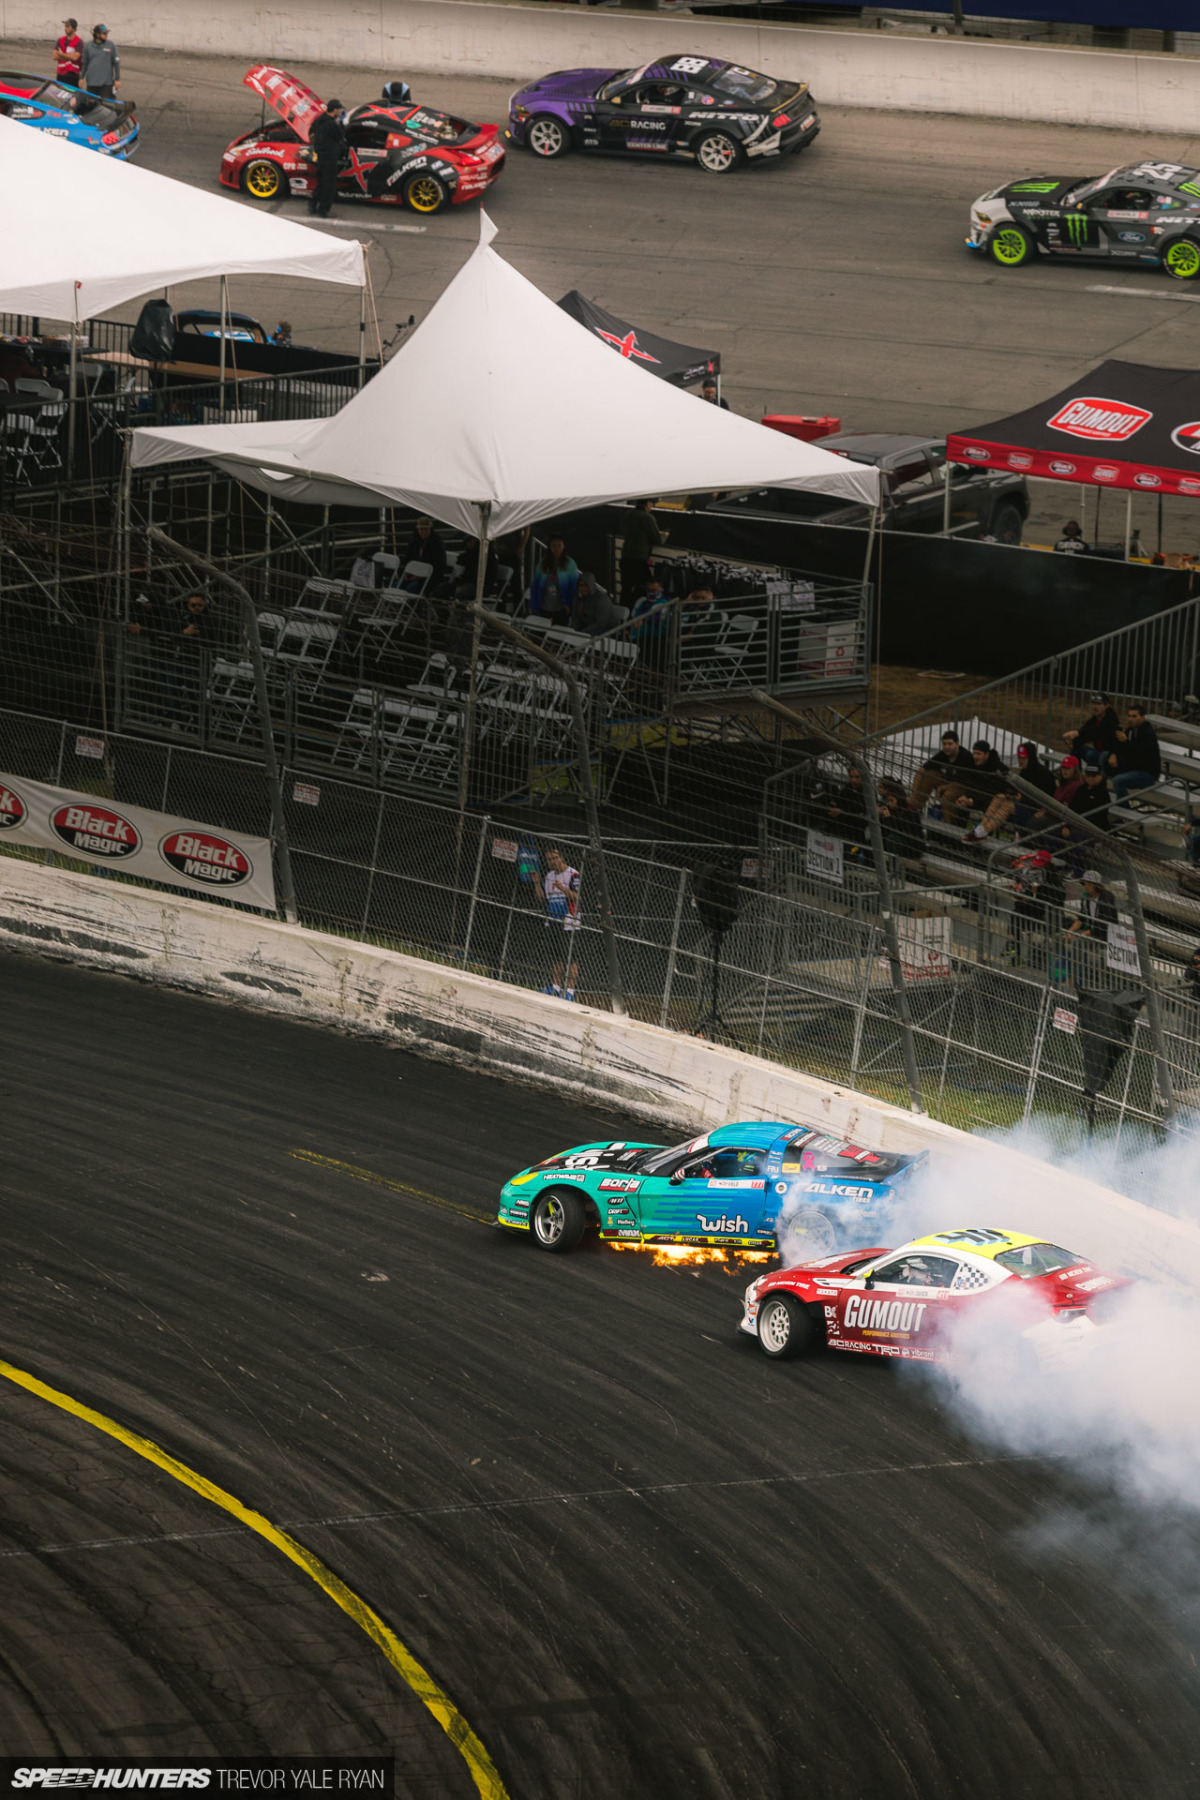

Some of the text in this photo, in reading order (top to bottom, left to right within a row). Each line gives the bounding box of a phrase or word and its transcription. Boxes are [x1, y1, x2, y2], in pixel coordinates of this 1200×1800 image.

[631, 120, 666, 130] RACING
[689, 112, 759, 121] NITTO
[386, 156, 427, 187] FALKEN
[1022, 208, 1060, 217] MONSTER
[1057, 402, 1144, 434] GUMOUT
[65, 808, 129, 842] Black
[74, 832, 129, 854] Magic
[175, 835, 242, 868] Black
[183, 859, 241, 882] Magic
[807, 848, 834, 872] SECTION
[697, 1214, 748, 1233] wish
[843, 1295, 927, 1332] GUMOUT
[844, 1341, 871, 1351] RACING
[872, 1344, 900, 1357] TRD
